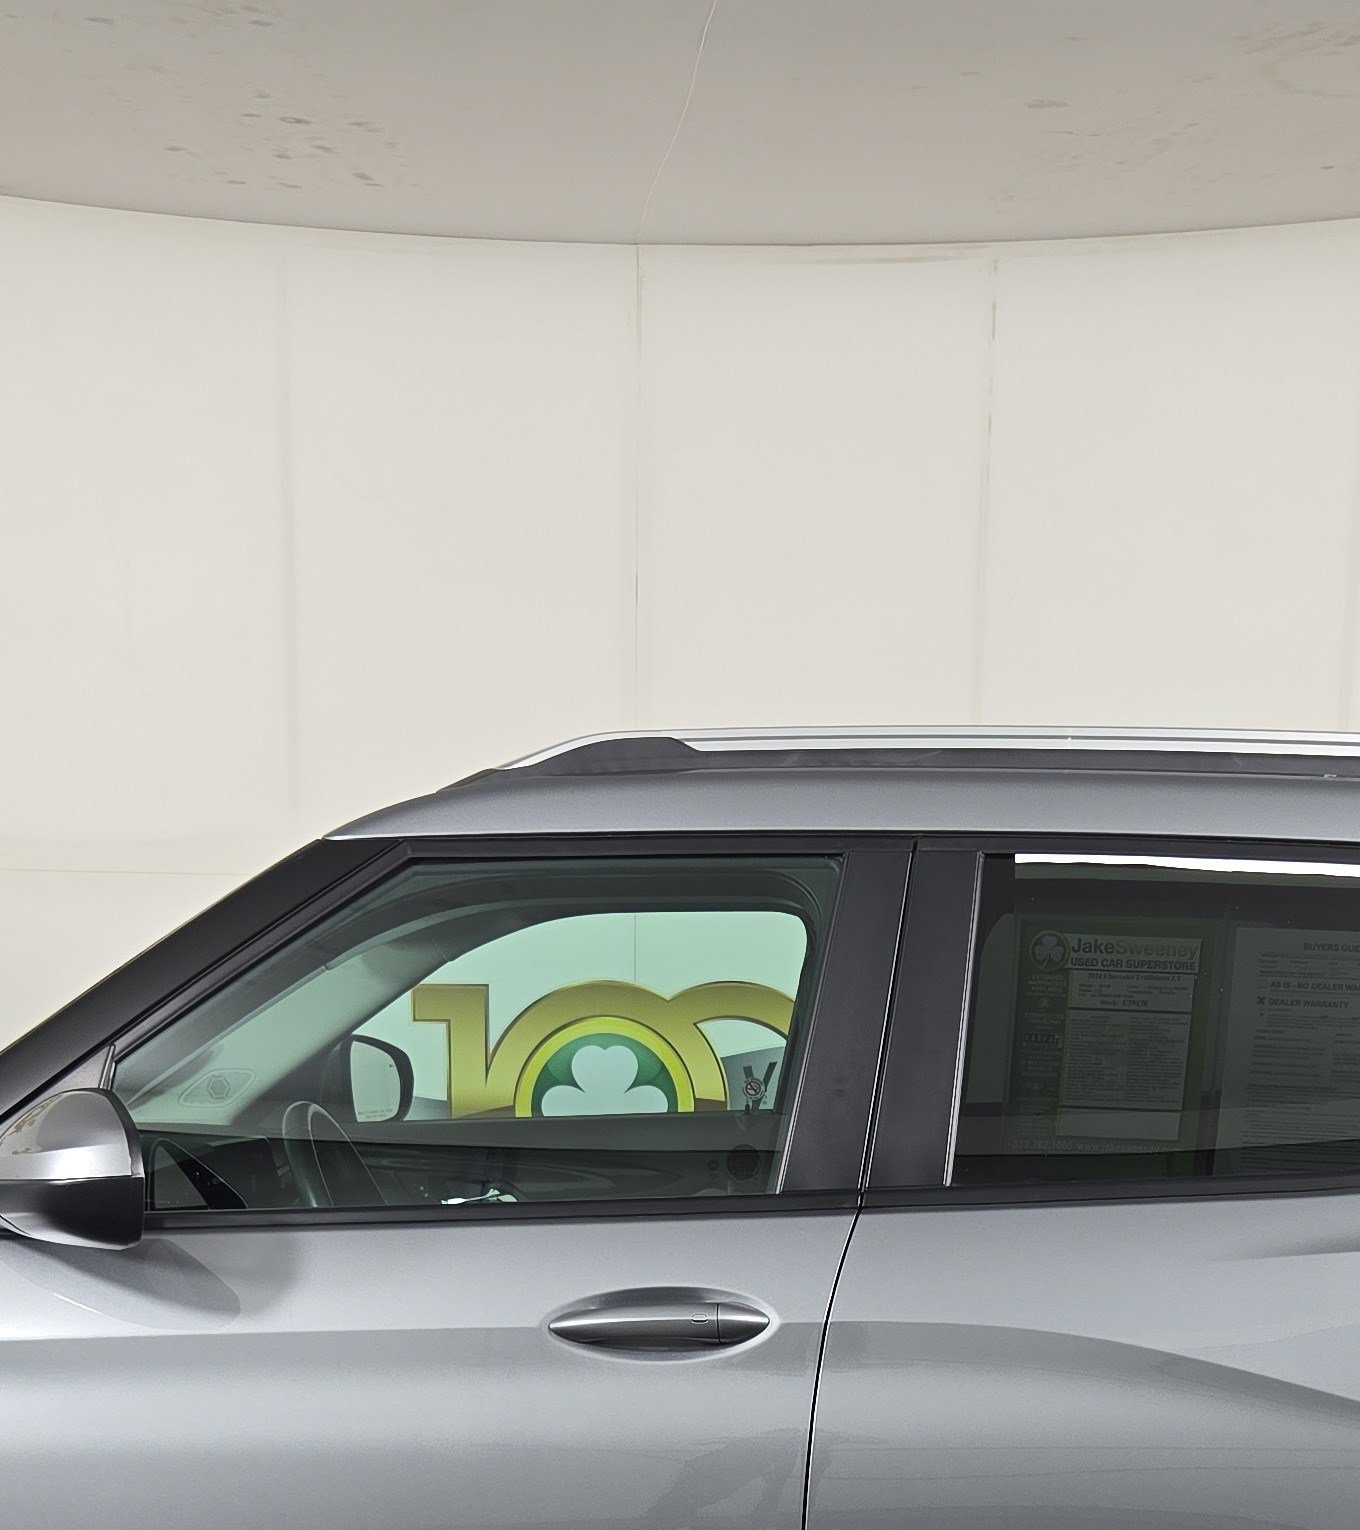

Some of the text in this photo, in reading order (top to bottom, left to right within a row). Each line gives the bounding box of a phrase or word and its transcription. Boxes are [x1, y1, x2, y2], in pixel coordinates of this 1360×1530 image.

[1303, 942, 1340, 953] BUYERS
[1071, 957, 1196, 971] USED CAR SUPERSTORE
[1269, 981, 1282, 989] AS
[1283, 981, 1291, 990] IS
[1297, 982, 1309, 991] NO
[1310, 983, 1345, 992] DEALER
[1268, 997, 1302, 1007] DEALER
[1303, 999, 1349, 1009] WARRANTY
